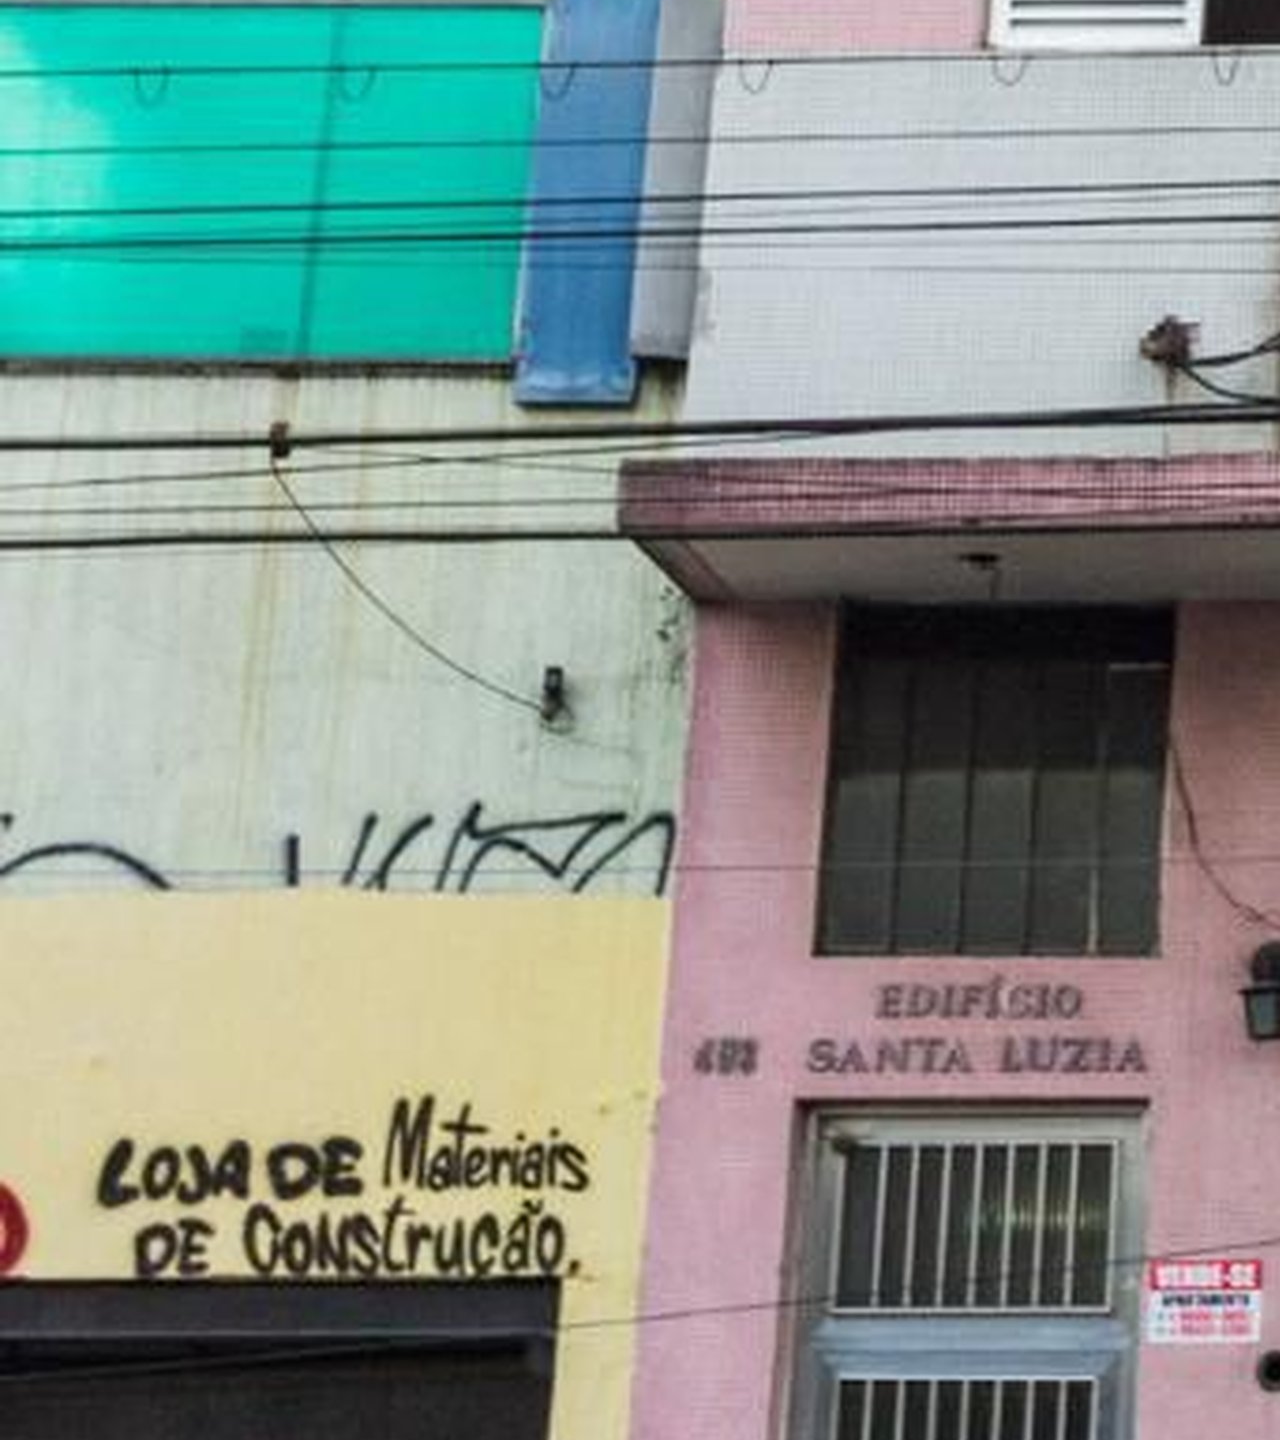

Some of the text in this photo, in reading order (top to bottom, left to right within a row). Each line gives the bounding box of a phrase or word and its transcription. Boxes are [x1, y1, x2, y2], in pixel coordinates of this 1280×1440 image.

[875, 977, 1082, 1020] EDIFÍCIO
[807, 1035, 1149, 1075] SANTA LUZIA
[97, 1094, 591, 1208] LOJA DE Materiais
[134, 1217, 216, 1278] DE
